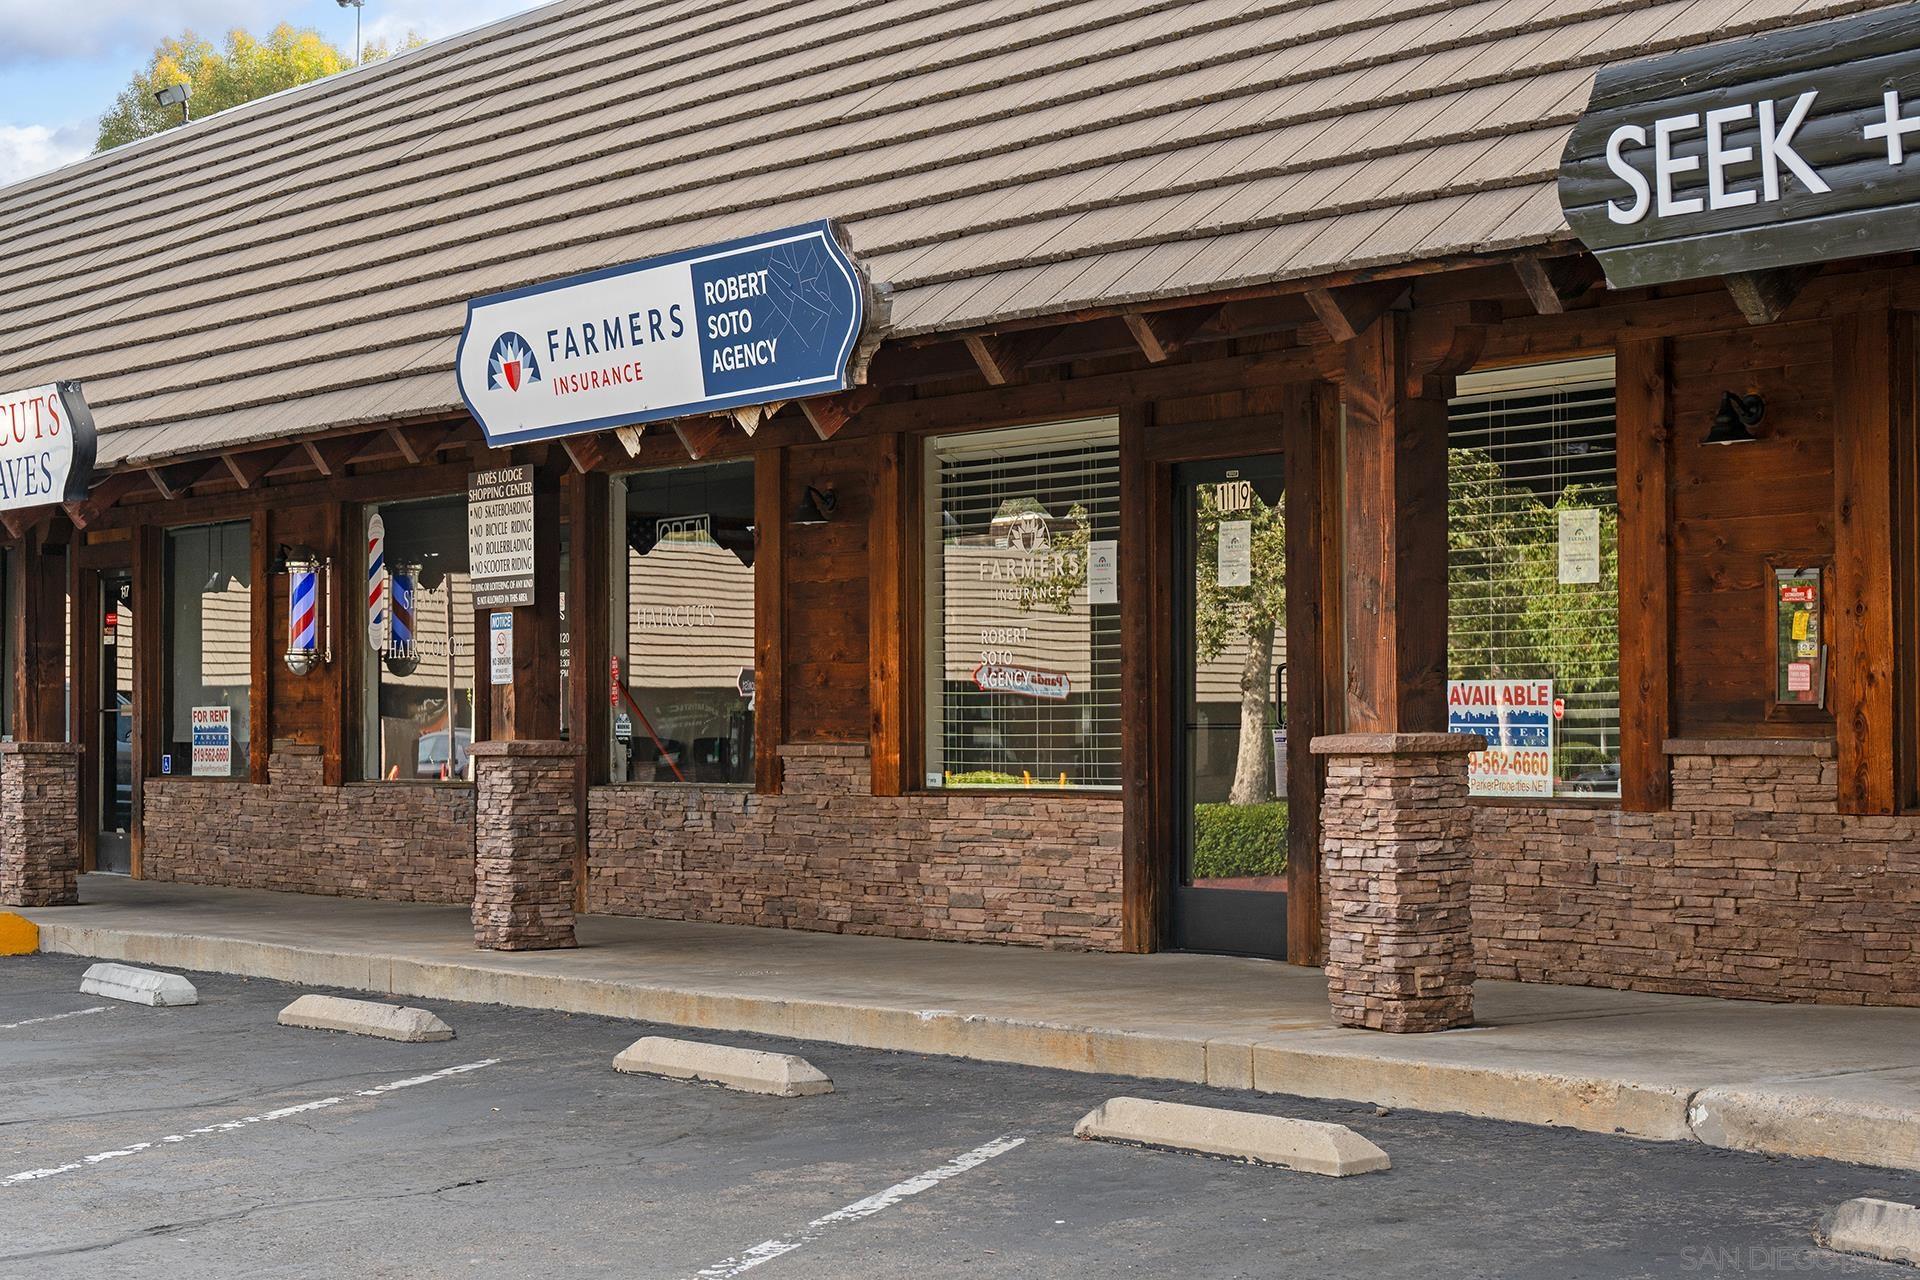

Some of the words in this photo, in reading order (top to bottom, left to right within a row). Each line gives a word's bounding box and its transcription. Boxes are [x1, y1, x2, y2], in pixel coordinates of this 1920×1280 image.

[1606, 90, 1832, 225] SEEK
[704, 269, 768, 306] ROBERT
[548, 304, 684, 363] FARMERS
[707, 309, 752, 339] SOTO
[711, 338, 777, 374] AGENCY
[553, 361, 644, 396] INSURANCE
[476, 472, 498, 486] AYRES
[499, 468, 523, 482] LODGE
[468, 485, 505, 502] SHOPPING
[506, 482, 533, 497] CENTER
[1220, 483, 1249, 511] 119
[473, 506, 483, 519] NO
[485, 500, 532, 518] SKATEBOARDING
[473, 525, 483, 538] NO
[486, 522, 508, 536] BICYCLE
[511, 519, 532, 533] RIDING
[474, 543, 483, 556] NO
[486, 538, 533, 554] ROLLERBLADING
[474, 561, 483, 574] NO
[484, 559, 511, 573] SCOOTER
[512, 556, 533, 571] RIDING
[979, 554, 1080, 581] FARMERS
[995, 585, 1063, 601] INSURANCE
[493, 616, 511, 628] NOTICE
[637, 604, 715, 629] HAIRCUTS
[981, 627, 1028, 645] ROBERT
[388, 638, 419, 660] HAIR
[422, 636, 464, 658] COLOR
[981, 650, 1013, 666] SOTO
[980, 671, 1030, 687] AGENCY
[1449, 685, 1549, 706] AVAILABLE
[193, 711, 208, 723] FOR
[209, 710, 228, 722] RENT
[1454, 727, 1546, 737] PARKER
[1469, 751, 1549, 776] 9-562-6660
[1471, 778, 1548, 793] ParkerProperties.NET
